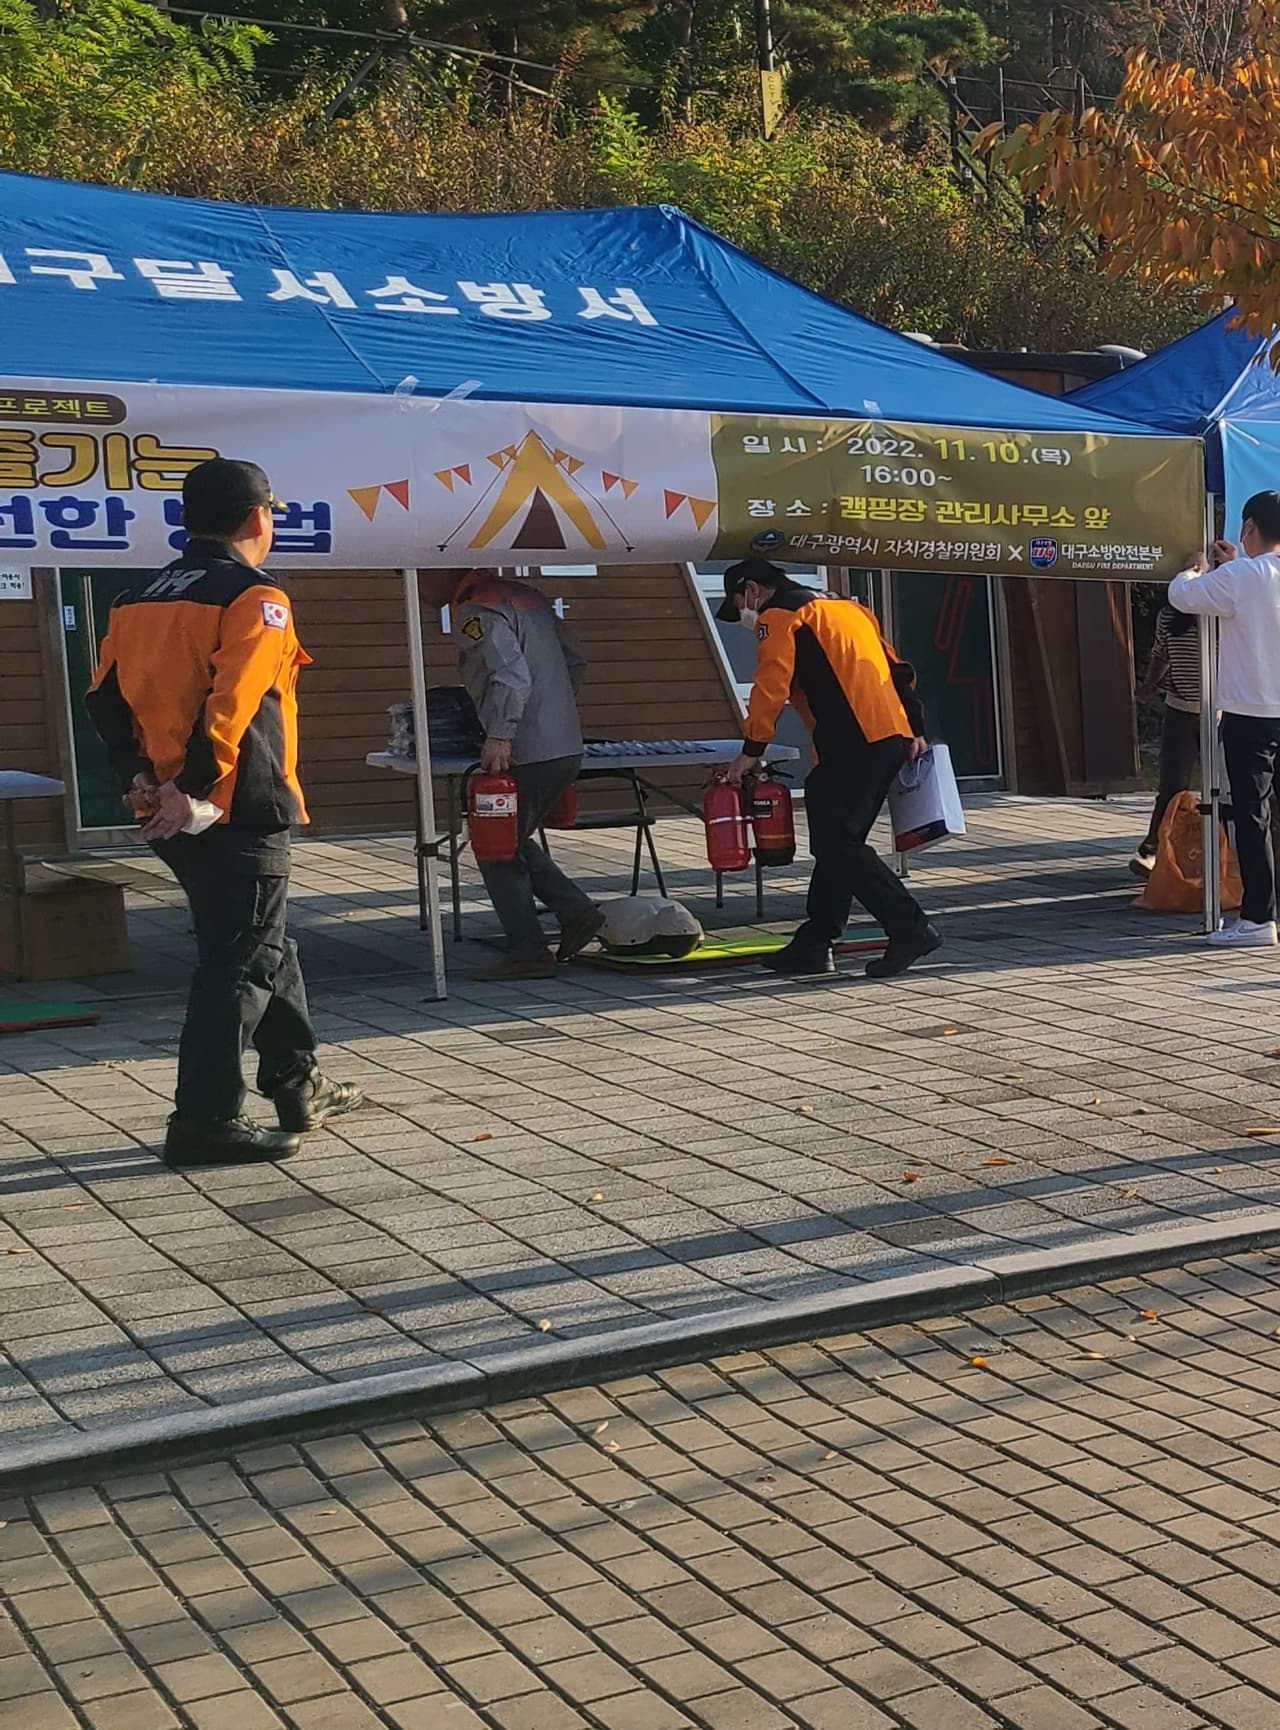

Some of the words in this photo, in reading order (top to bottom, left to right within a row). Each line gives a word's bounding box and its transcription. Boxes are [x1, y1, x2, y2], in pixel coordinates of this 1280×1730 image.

[0, 247, 659, 326] 구달서소방서
[846, 437, 924, 459] 2022.
[934, 438, 976, 461] 11.
[861, 464, 953, 487] 16:00~
[163, 499, 332, 553] 법
[839, 495, 926, 523] 캠핑장
[935, 502, 1076, 528] 관리사무소
[1083, 506, 1111, 531] 앞
[788, 533, 880, 556] 대구광역시
[885, 539, 1001, 562] 자치경찰위원회
[1061, 543, 1164, 562] 대구소방안전본부
[1112, 562, 1154, 571] DEPARTMENT
